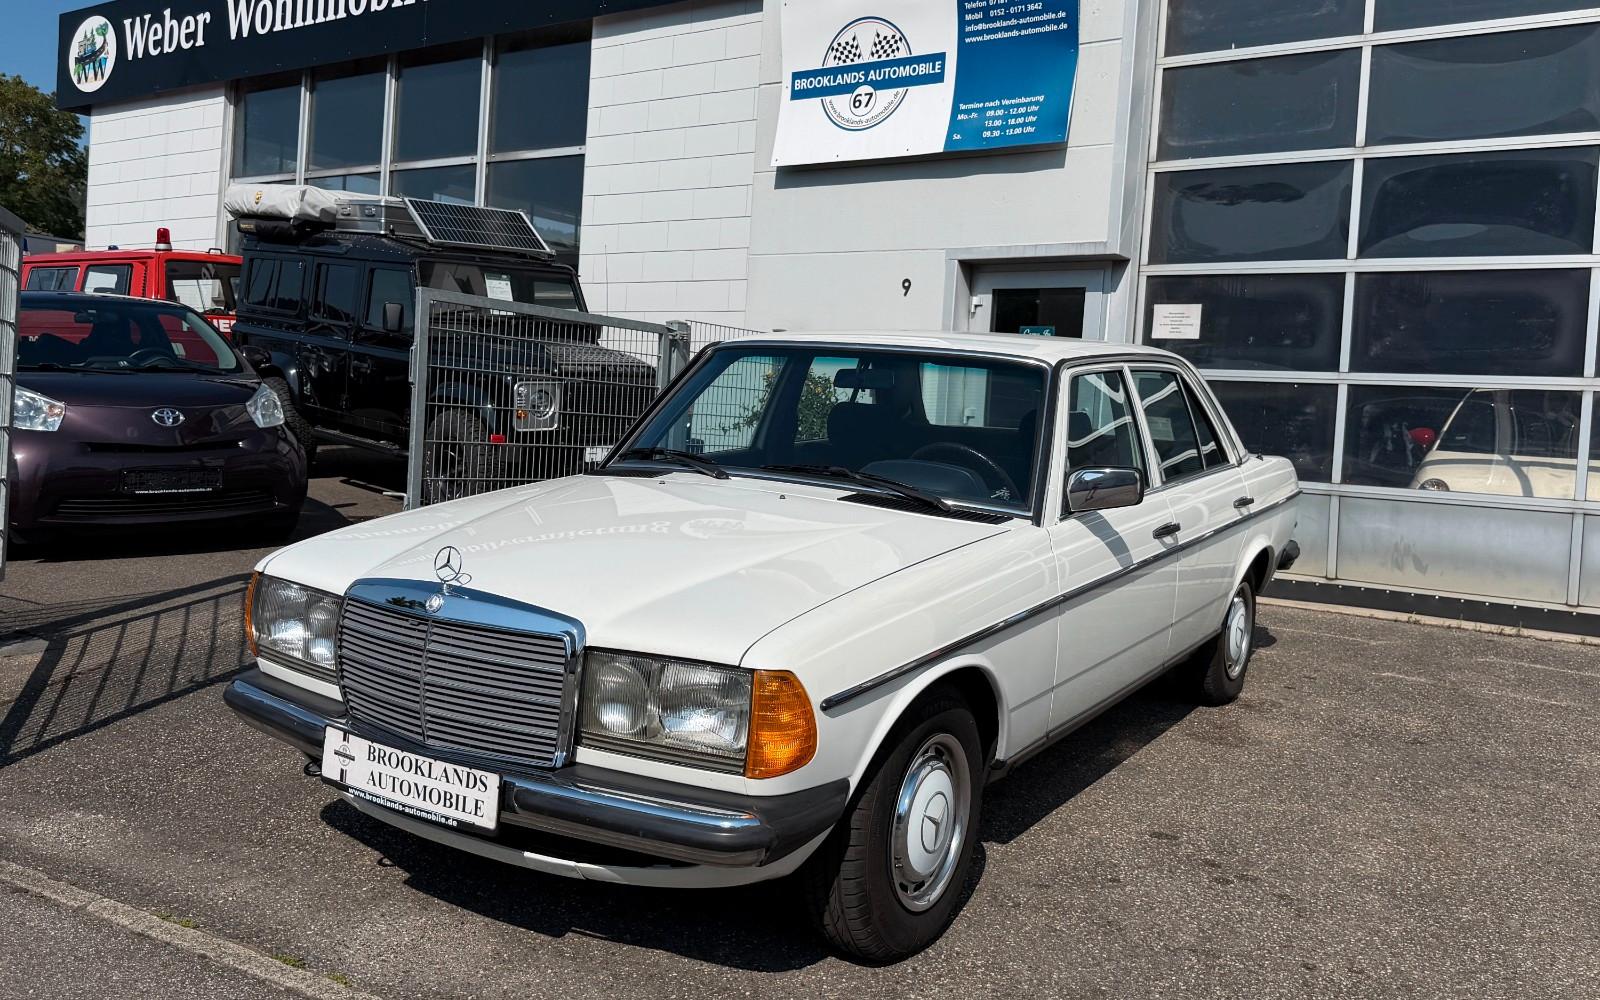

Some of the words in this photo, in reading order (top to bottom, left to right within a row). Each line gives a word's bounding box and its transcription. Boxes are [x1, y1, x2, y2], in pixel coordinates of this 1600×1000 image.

[965, 1, 987, 10] Telefon
[965, 12, 983, 21] Mobil
[989, 9, 1005, 17] 0152
[1010, 5, 1025, 14] 0171
[1026, 2, 1043, 12] 3642
[965, 10, 1067, 33] info@brooklands-automobile.de
[123, 8, 211, 61] Weber
[965, 22, 1068, 43] www.brooklands-automobile.de
[794, 70, 865, 91] BROOKLANDS
[867, 61, 942, 82] AUTOMOBILE
[852, 92, 874, 109] 67
[959, 102, 984, 111] Termine
[985, 99, 1000, 108] nach
[1001, 94, 1045, 106] Vereinbarung
[986, 109, 1004, 117] 09.00
[1009, 106, 1027, 115] 12.00
[1027, 104, 1040, 112] Uhr
[984, 120, 1002, 128] 13.00
[1025, 115, 1038, 123] Uhr
[982, 130, 1000, 138] 09.30
[1005, 127, 1022, 136] 13.00
[1023, 125, 1036, 133] Uhr
[901, 278, 912, 297] 9
[367, 744, 489, 793] BROOKLANDS
[366, 770, 485, 818] AUTOMOBILE
[348, 787, 458, 827] www.brooklands-automobile.de
